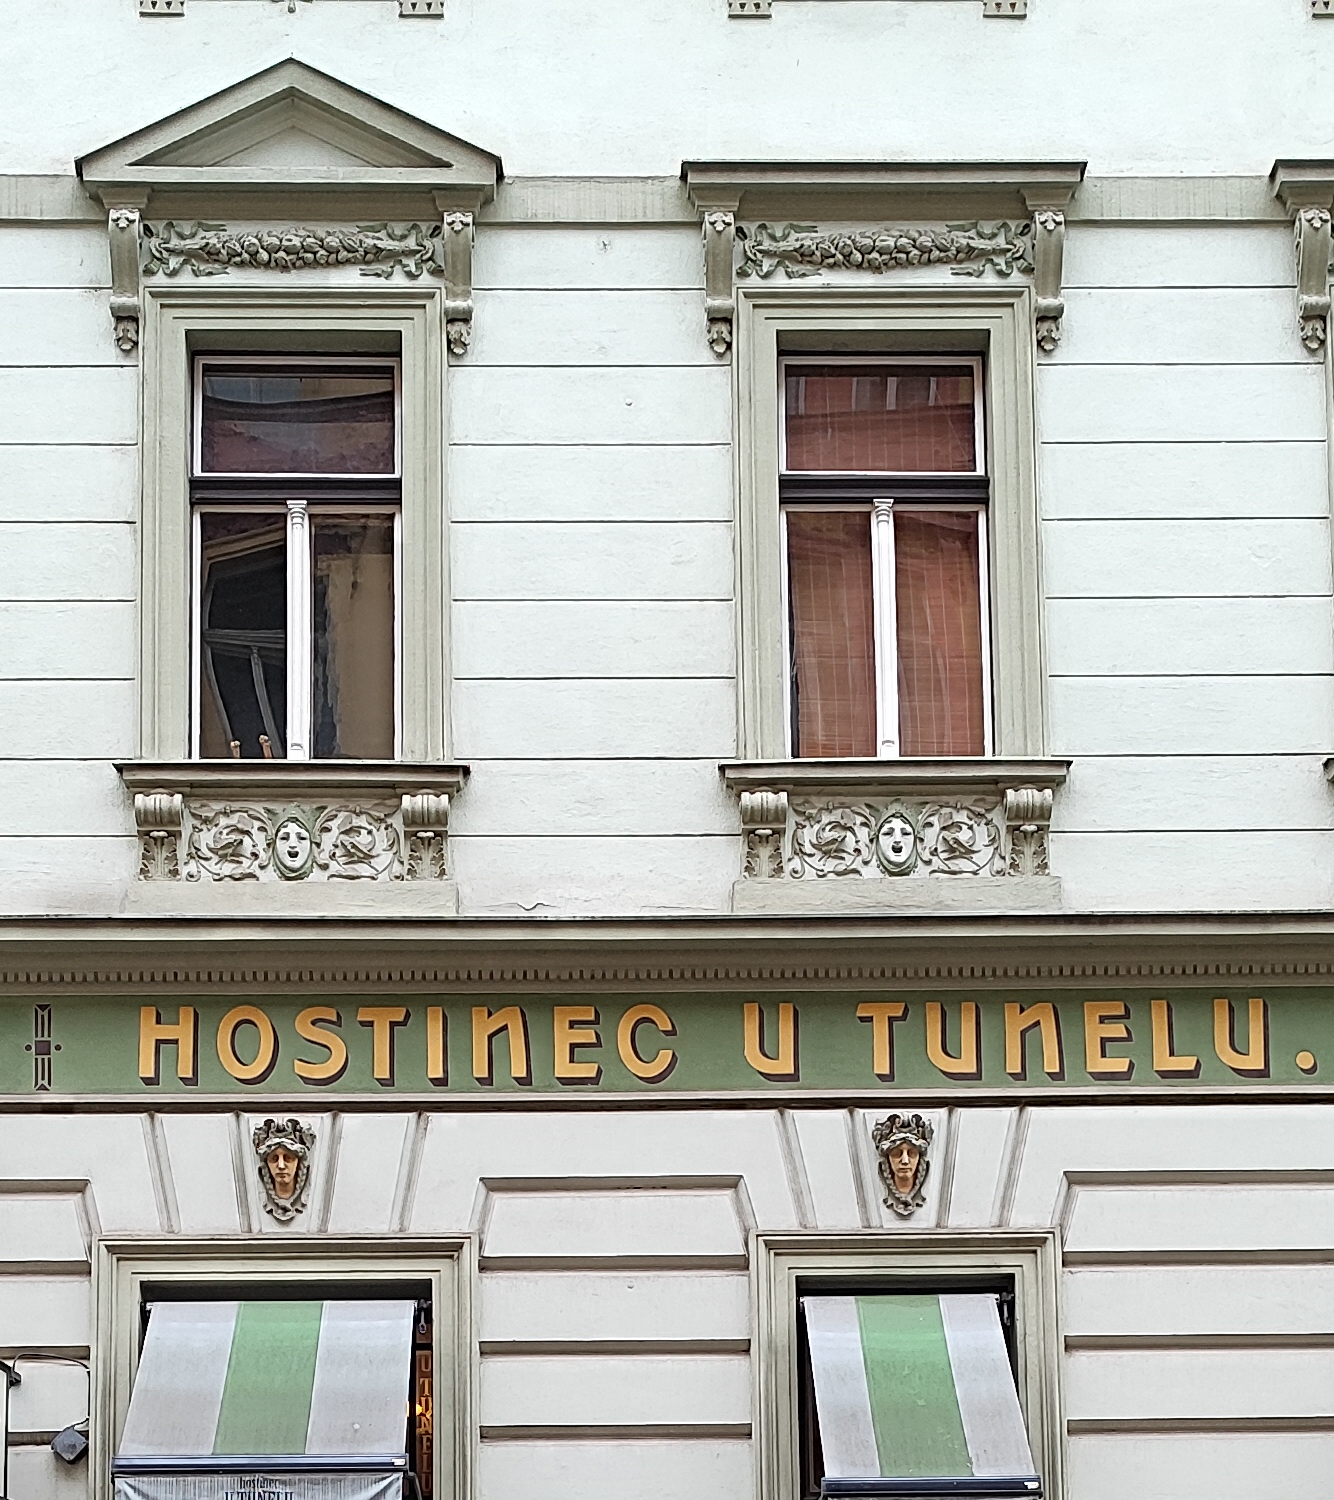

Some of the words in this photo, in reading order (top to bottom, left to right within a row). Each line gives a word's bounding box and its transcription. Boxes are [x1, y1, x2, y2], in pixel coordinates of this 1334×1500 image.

[138, 1003, 676, 1086] HOSTINEC
[743, 1001, 798, 1081] U
[856, 998, 1318, 1081] TUNELU.
